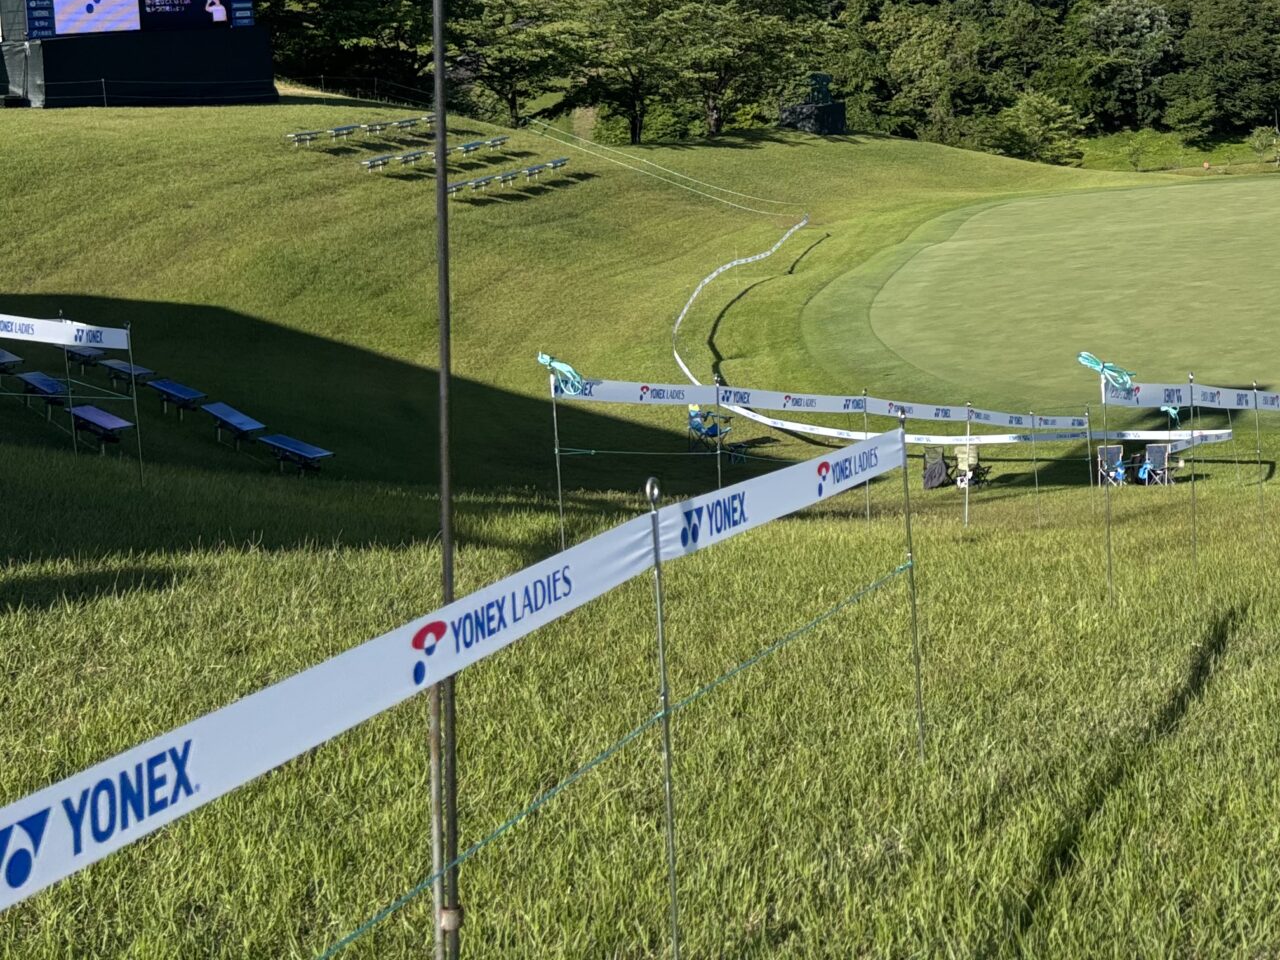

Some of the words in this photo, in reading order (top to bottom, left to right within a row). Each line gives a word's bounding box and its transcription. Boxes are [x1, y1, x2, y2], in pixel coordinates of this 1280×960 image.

[0, 321, 14, 333] ONEX
[15, 323, 35, 335] LADIES
[86, 328, 104, 343] YONEX
[651, 388, 665, 399] YONEX
[666, 389, 685, 400] LADIES
[733, 391, 751, 405] YONEX
[831, 457, 853, 484] YONEX
[853, 446, 879, 475] LADIES
[707, 491, 747, 536] YONEX
[450, 595, 508, 654] YONEX
[511, 565, 573, 623] LADIES
[61, 739, 194, 856] YONEX
